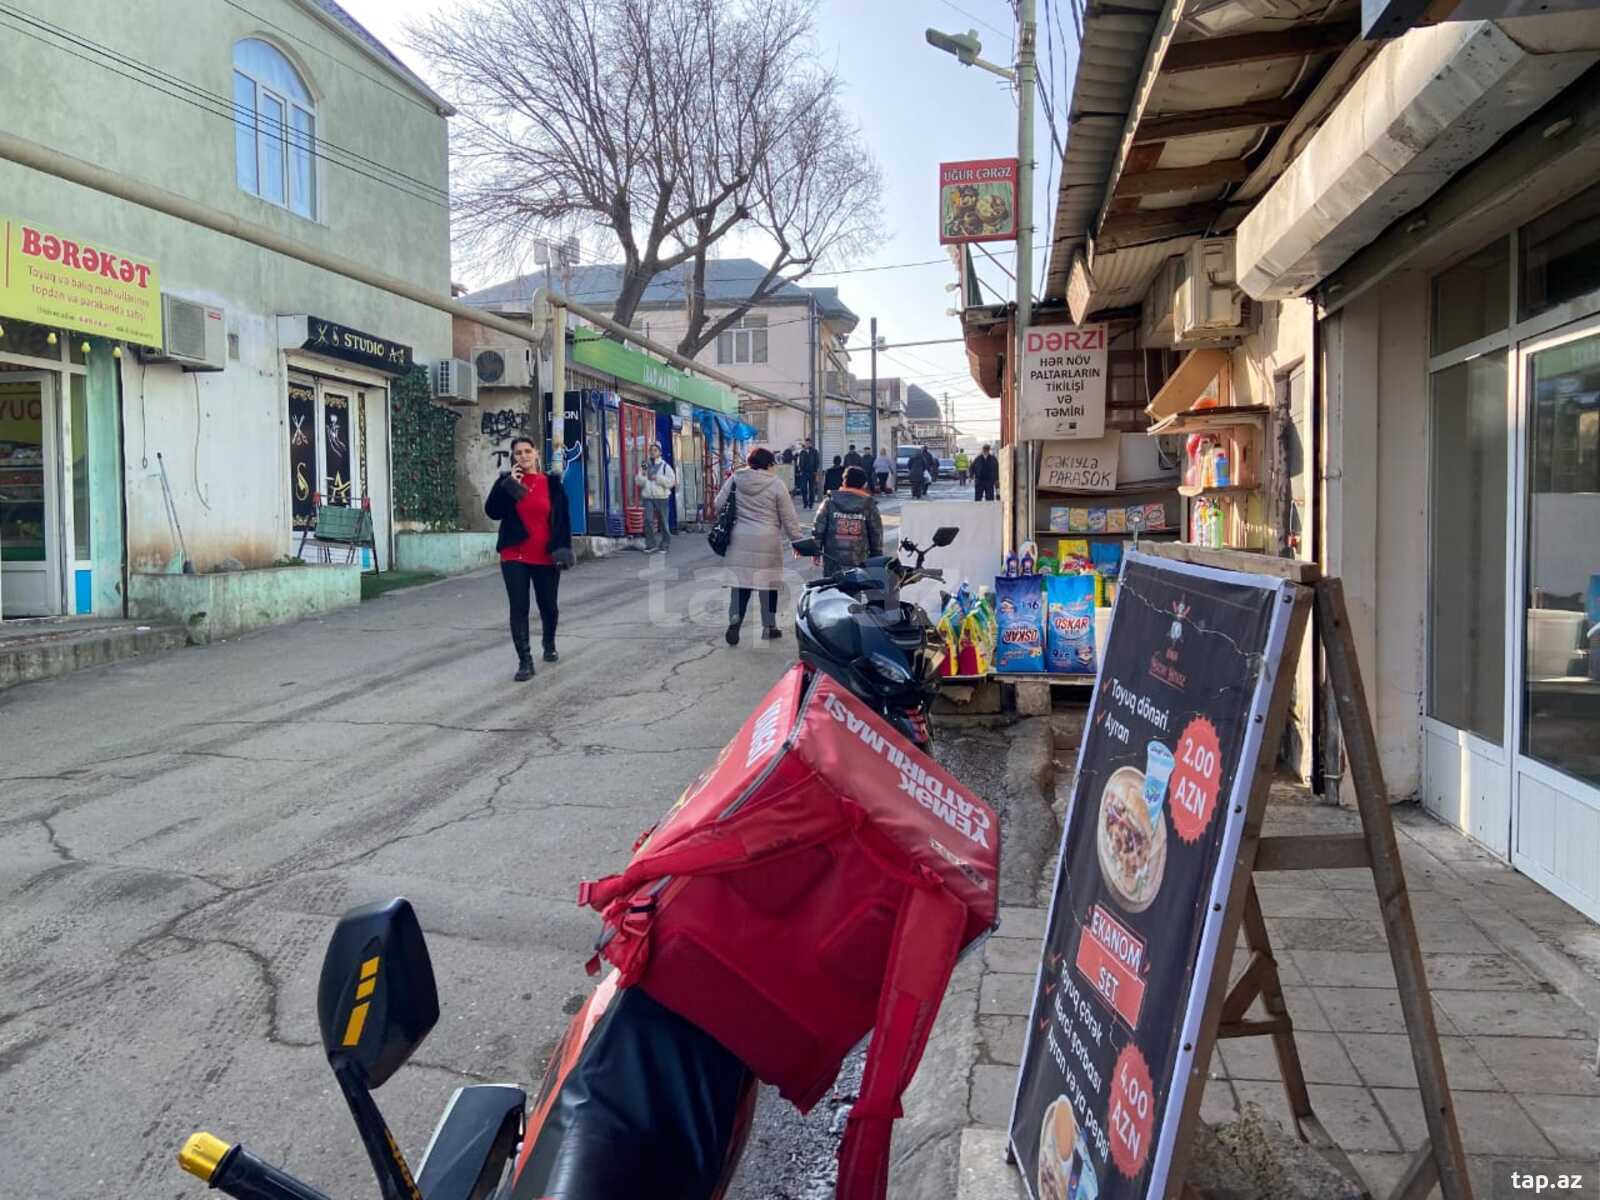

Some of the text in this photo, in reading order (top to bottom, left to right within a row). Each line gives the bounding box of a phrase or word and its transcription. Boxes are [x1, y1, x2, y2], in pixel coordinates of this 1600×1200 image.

[21, 226, 151, 288] BƏRƏKƏT
[344, 333, 384, 357] STUDIO
[1040, 353, 1091, 367] HƏR NÖV
[1030, 368, 1100, 380] PALTARLARIN
[1057, 394, 1072, 405] VƏ
[1055, 616, 1089, 630] OSKAR
[1112, 678, 1169, 731] Toyuq dönəri
[1105, 711, 1129, 744] Ayran
[1183, 737, 1214, 778] 2.00
[1175, 776, 1206, 820] AZN
[1091, 911, 1140, 974] EKANOM
[1099, 966, 1118, 1003] SET
[1120, 1062, 1148, 1120] 4.00
[1084, 1107, 1110, 1164] pepsi
[1112, 1099, 1141, 1160] AZN
